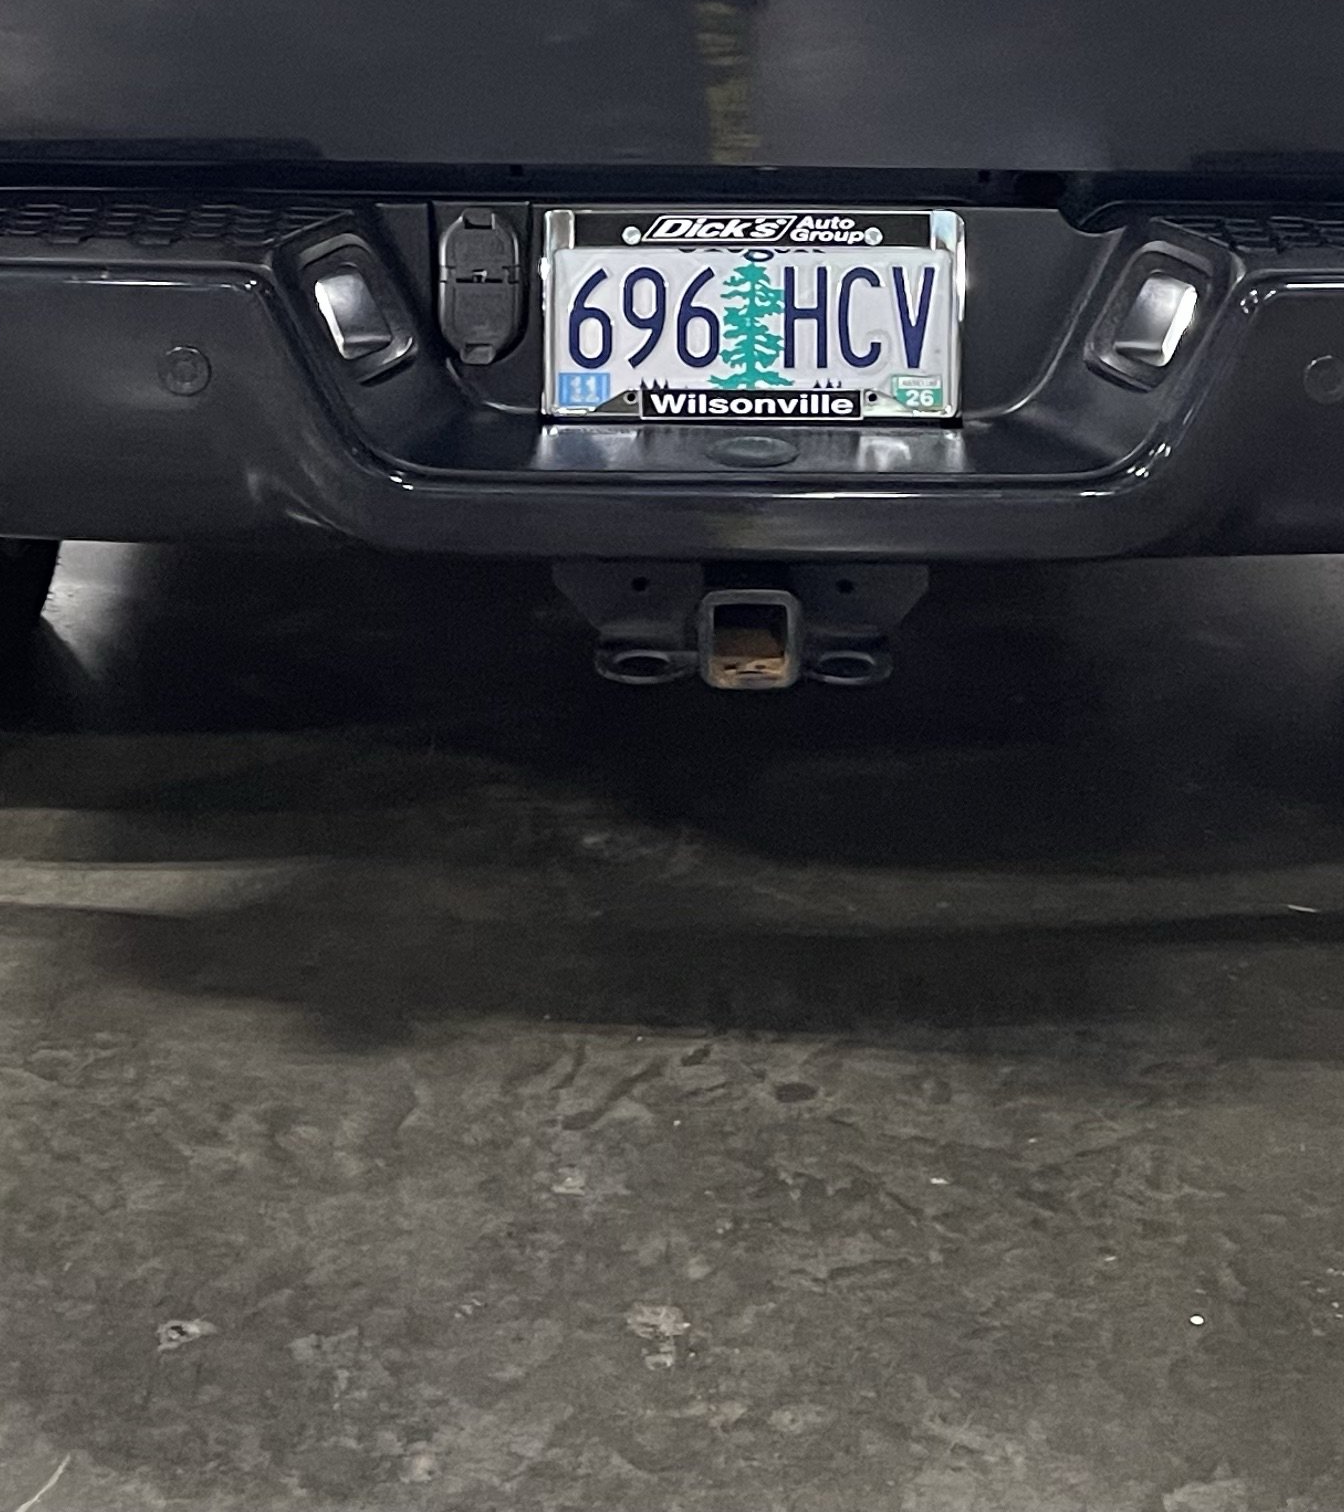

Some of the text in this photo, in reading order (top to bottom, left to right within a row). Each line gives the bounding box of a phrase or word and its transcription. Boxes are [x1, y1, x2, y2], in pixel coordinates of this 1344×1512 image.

[652, 217, 784, 239] Dick's
[796, 216, 855, 230] Auto
[789, 228, 865, 244] Group
[568, 266, 936, 369] 696 HCV
[649, 392, 854, 415] Wilsonville
[905, 389, 935, 408] 26
